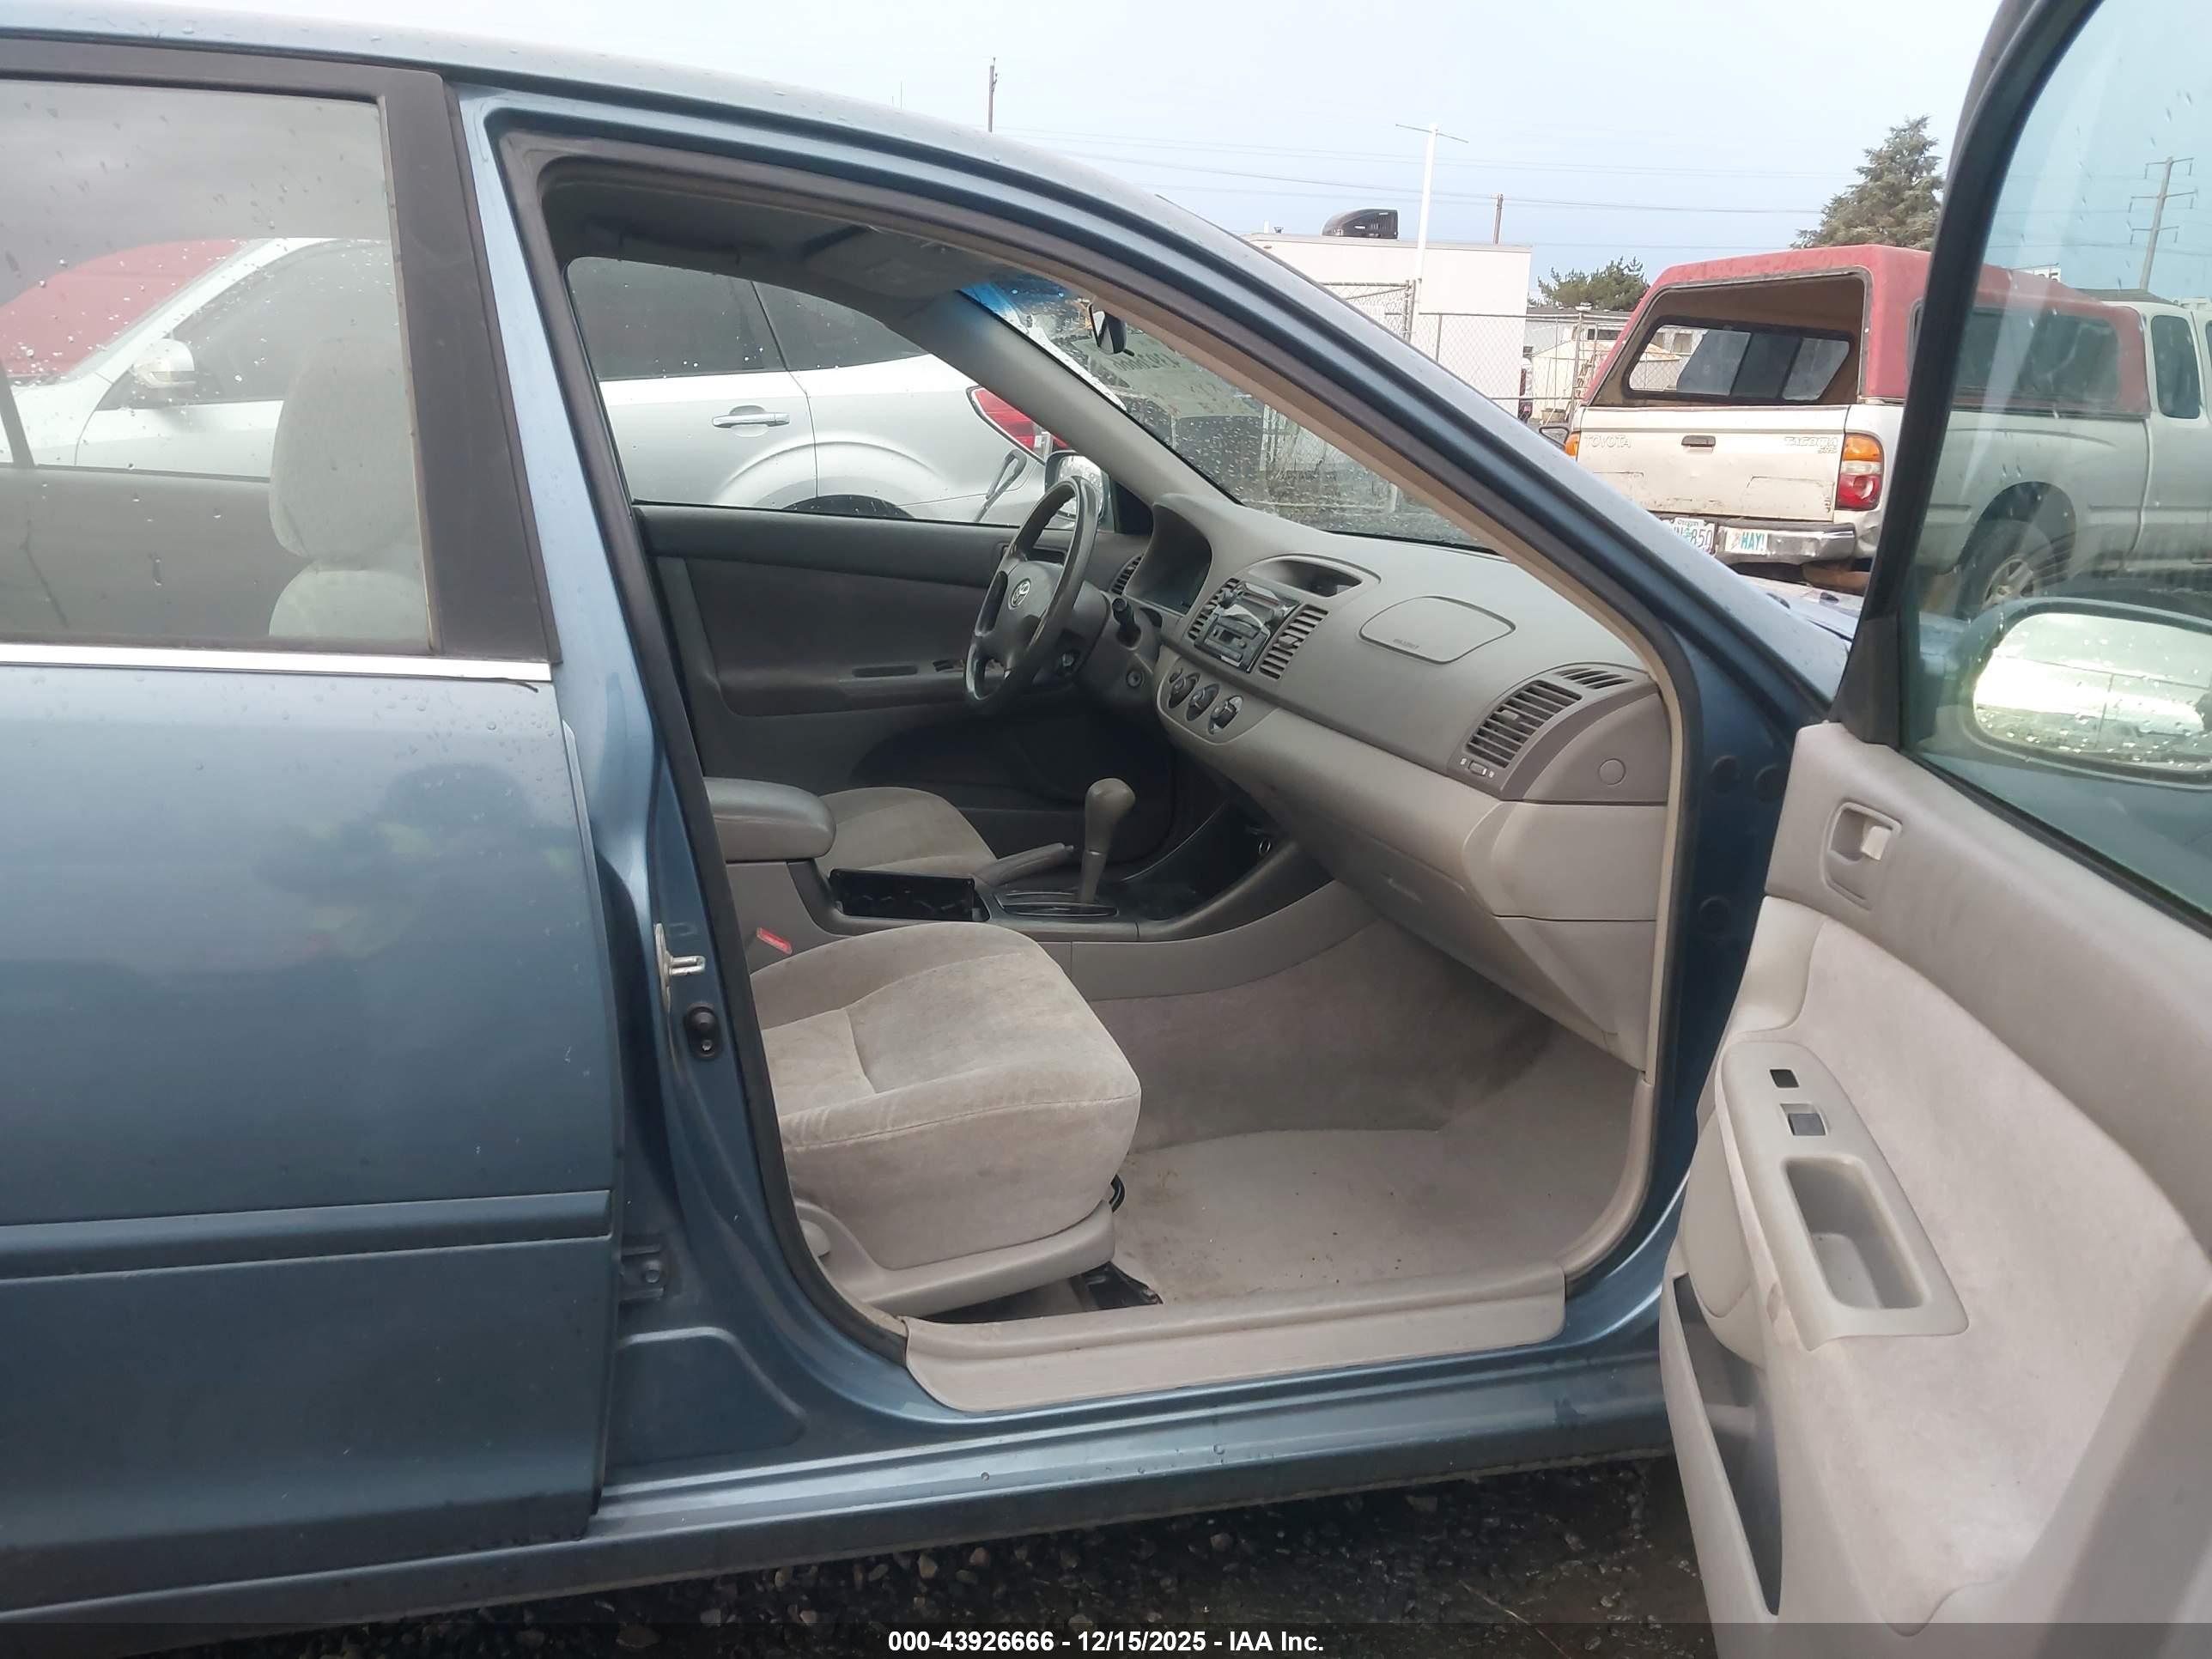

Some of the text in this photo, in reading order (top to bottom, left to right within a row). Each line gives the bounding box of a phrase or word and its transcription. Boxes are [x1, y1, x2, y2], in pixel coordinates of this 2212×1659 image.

[1584, 434, 1632, 448] TOYOTA
[1784, 436, 1838, 447] TACOMA
[1741, 532, 1765, 551] HAY!
